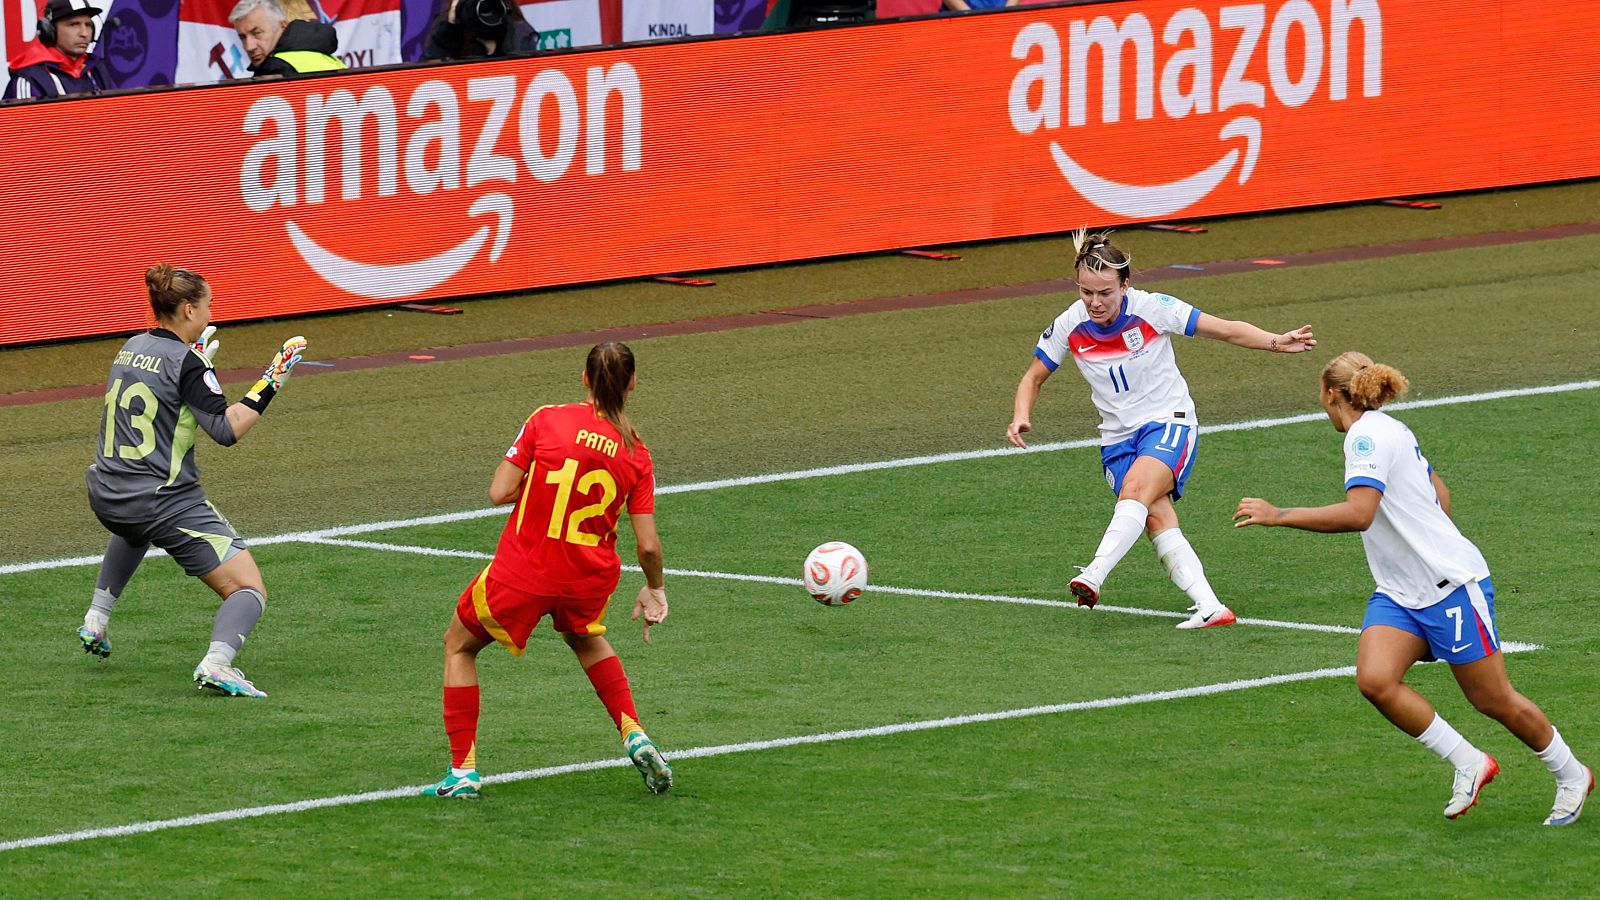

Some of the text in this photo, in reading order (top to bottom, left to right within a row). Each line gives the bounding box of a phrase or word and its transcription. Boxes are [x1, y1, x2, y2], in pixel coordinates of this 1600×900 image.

[1008, 0, 1382, 134] amazon
[239, 61, 642, 211] amazon
[132, 353, 162, 374] COLL
[1108, 363, 1130, 394] 11
[104, 378, 159, 461] 13
[1160, 421, 1182, 448] 11
[575, 429, 619, 458] PATRI
[545, 457, 618, 548] 12
[1445, 605, 1464, 642] 7
